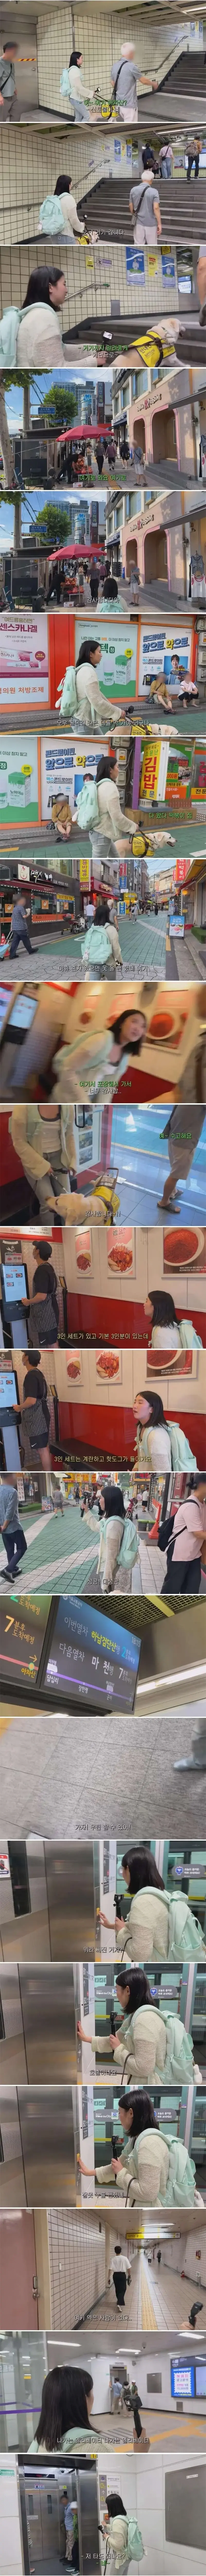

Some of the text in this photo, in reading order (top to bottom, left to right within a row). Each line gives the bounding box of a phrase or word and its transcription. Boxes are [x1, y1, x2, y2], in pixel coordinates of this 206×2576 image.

[0, 623, 38, 633] 센스카나겔
[144, 756, 157, 790] 김밥
[142, 789, 155, 798] 전문
[19, 1599, 40, 1615] 도착예정
[4, 1615, 14, 1632] 7
[14, 1621, 26, 1631] 분후
[12, 1630, 34, 1644] 도착예정
[64, 1617, 120, 1655] 이번열차 하남검단산행
[131, 1637, 140, 1647] 18:15
[59, 1643, 85, 1662] 다음열차
[121, 1646, 126, 1658] 2
[21, 1668, 36, 1678] 아차산
[119, 1667, 123, 1679] 7
[47, 1675, 59, 1684] 답십리
[78, 1685, 88, 1693] 장한평
